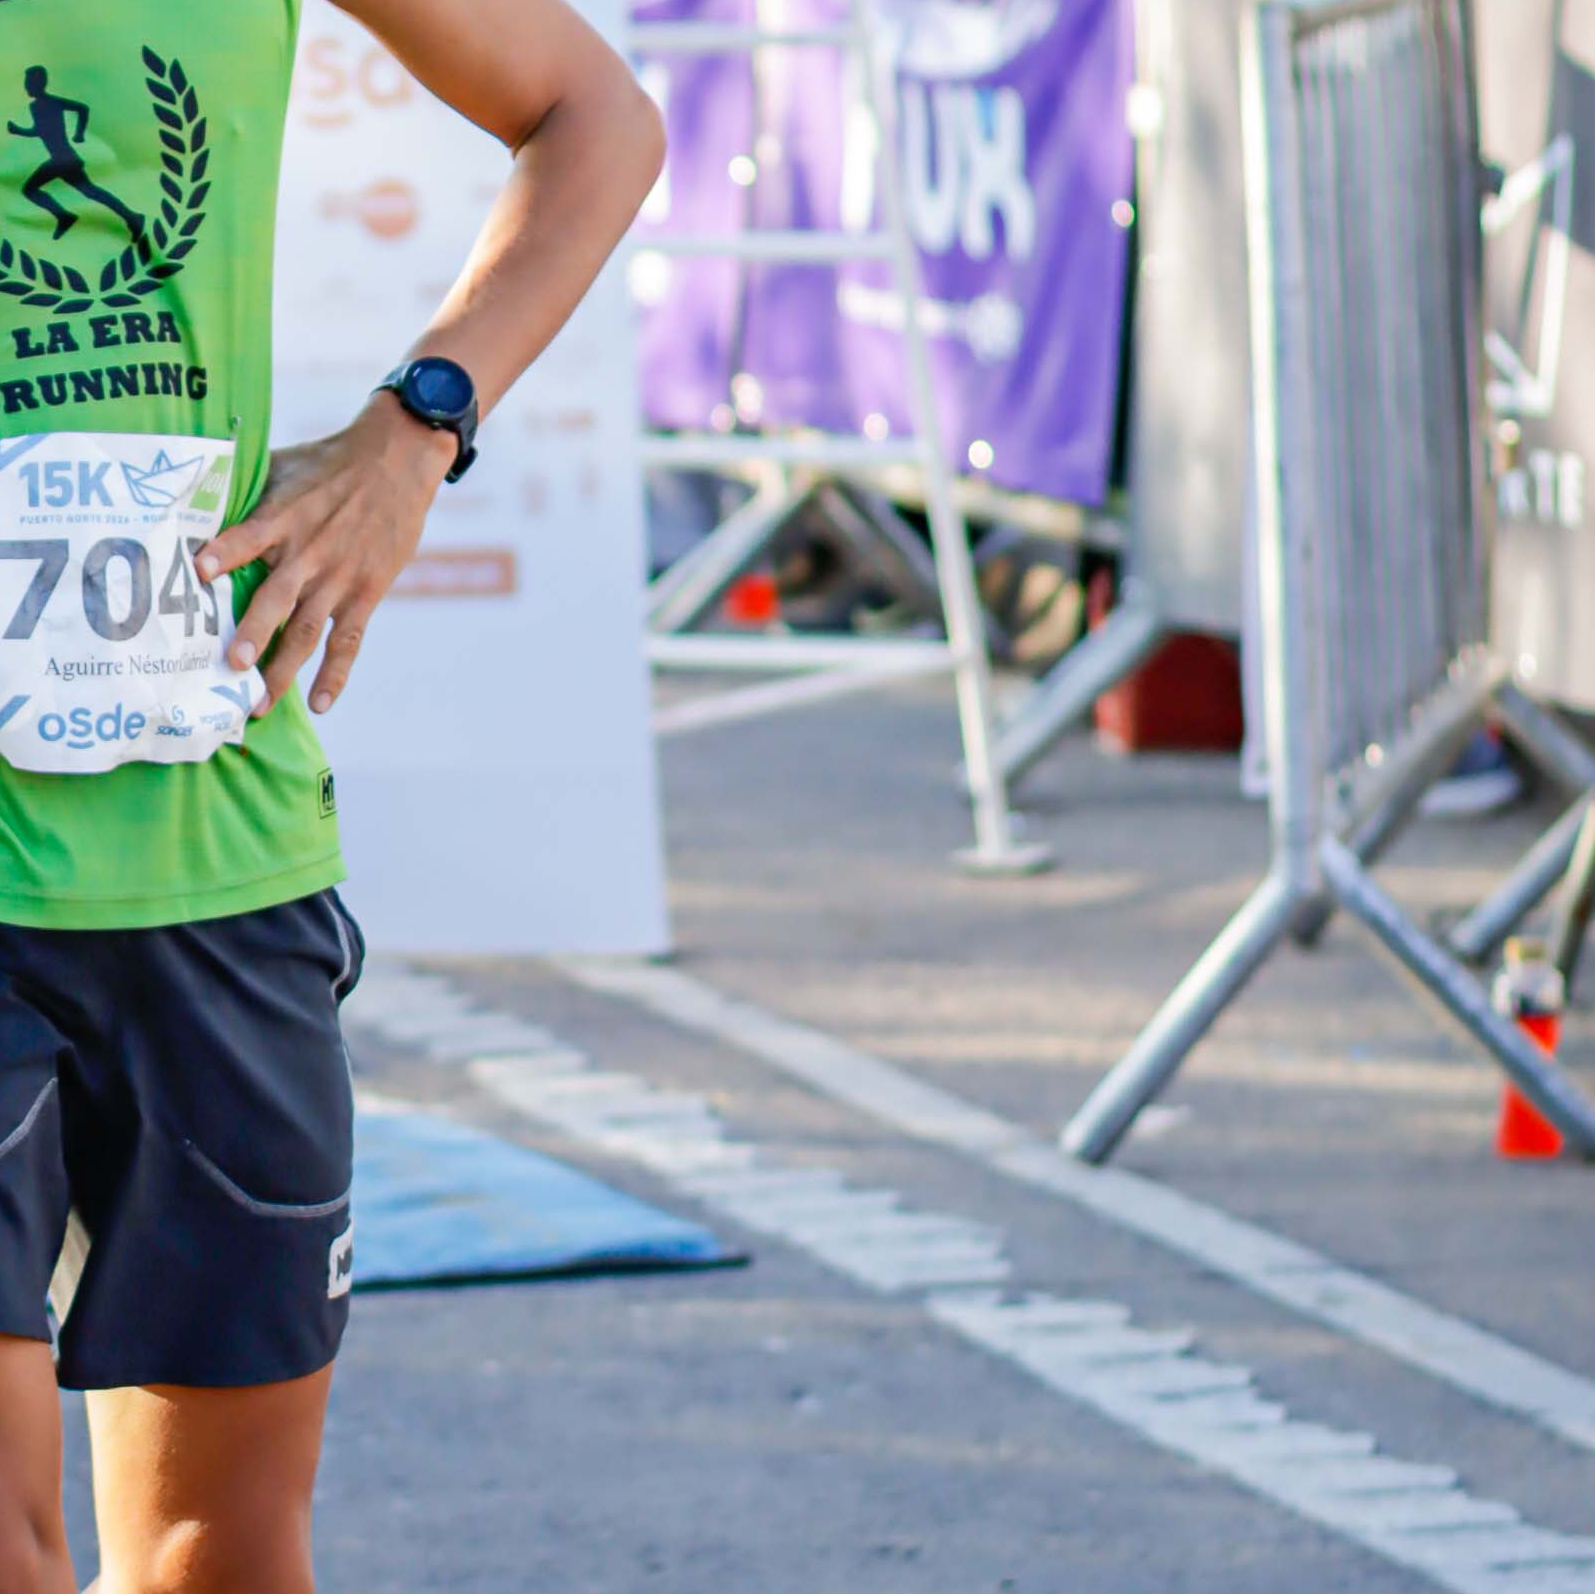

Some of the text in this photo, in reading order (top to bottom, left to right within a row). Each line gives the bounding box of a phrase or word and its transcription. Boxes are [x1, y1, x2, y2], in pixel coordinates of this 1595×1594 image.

[11, 311, 181, 358] LA ERA
[18, 461, 114, 507] 15K
[45, 657, 123, 682] Aguirre
[38, 701, 146, 743] osde
